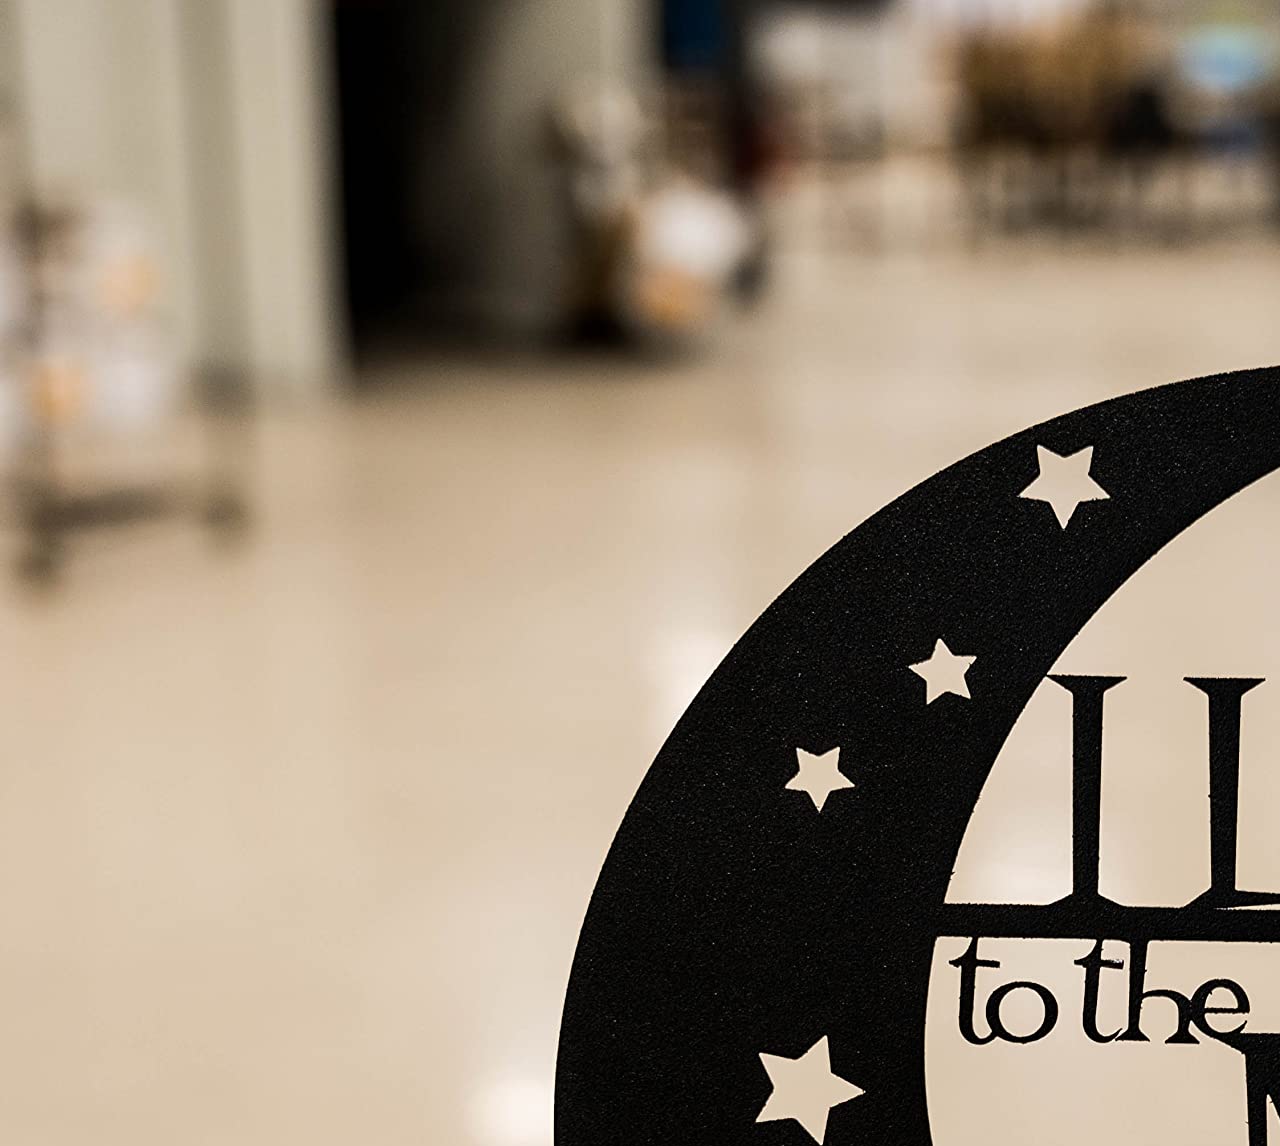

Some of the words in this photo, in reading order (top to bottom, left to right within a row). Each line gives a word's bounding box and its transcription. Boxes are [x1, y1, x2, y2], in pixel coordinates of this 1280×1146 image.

[1046, 674, 1128, 907] I
[949, 936, 1059, 1045] to
[1074, 936, 1251, 1044] the
